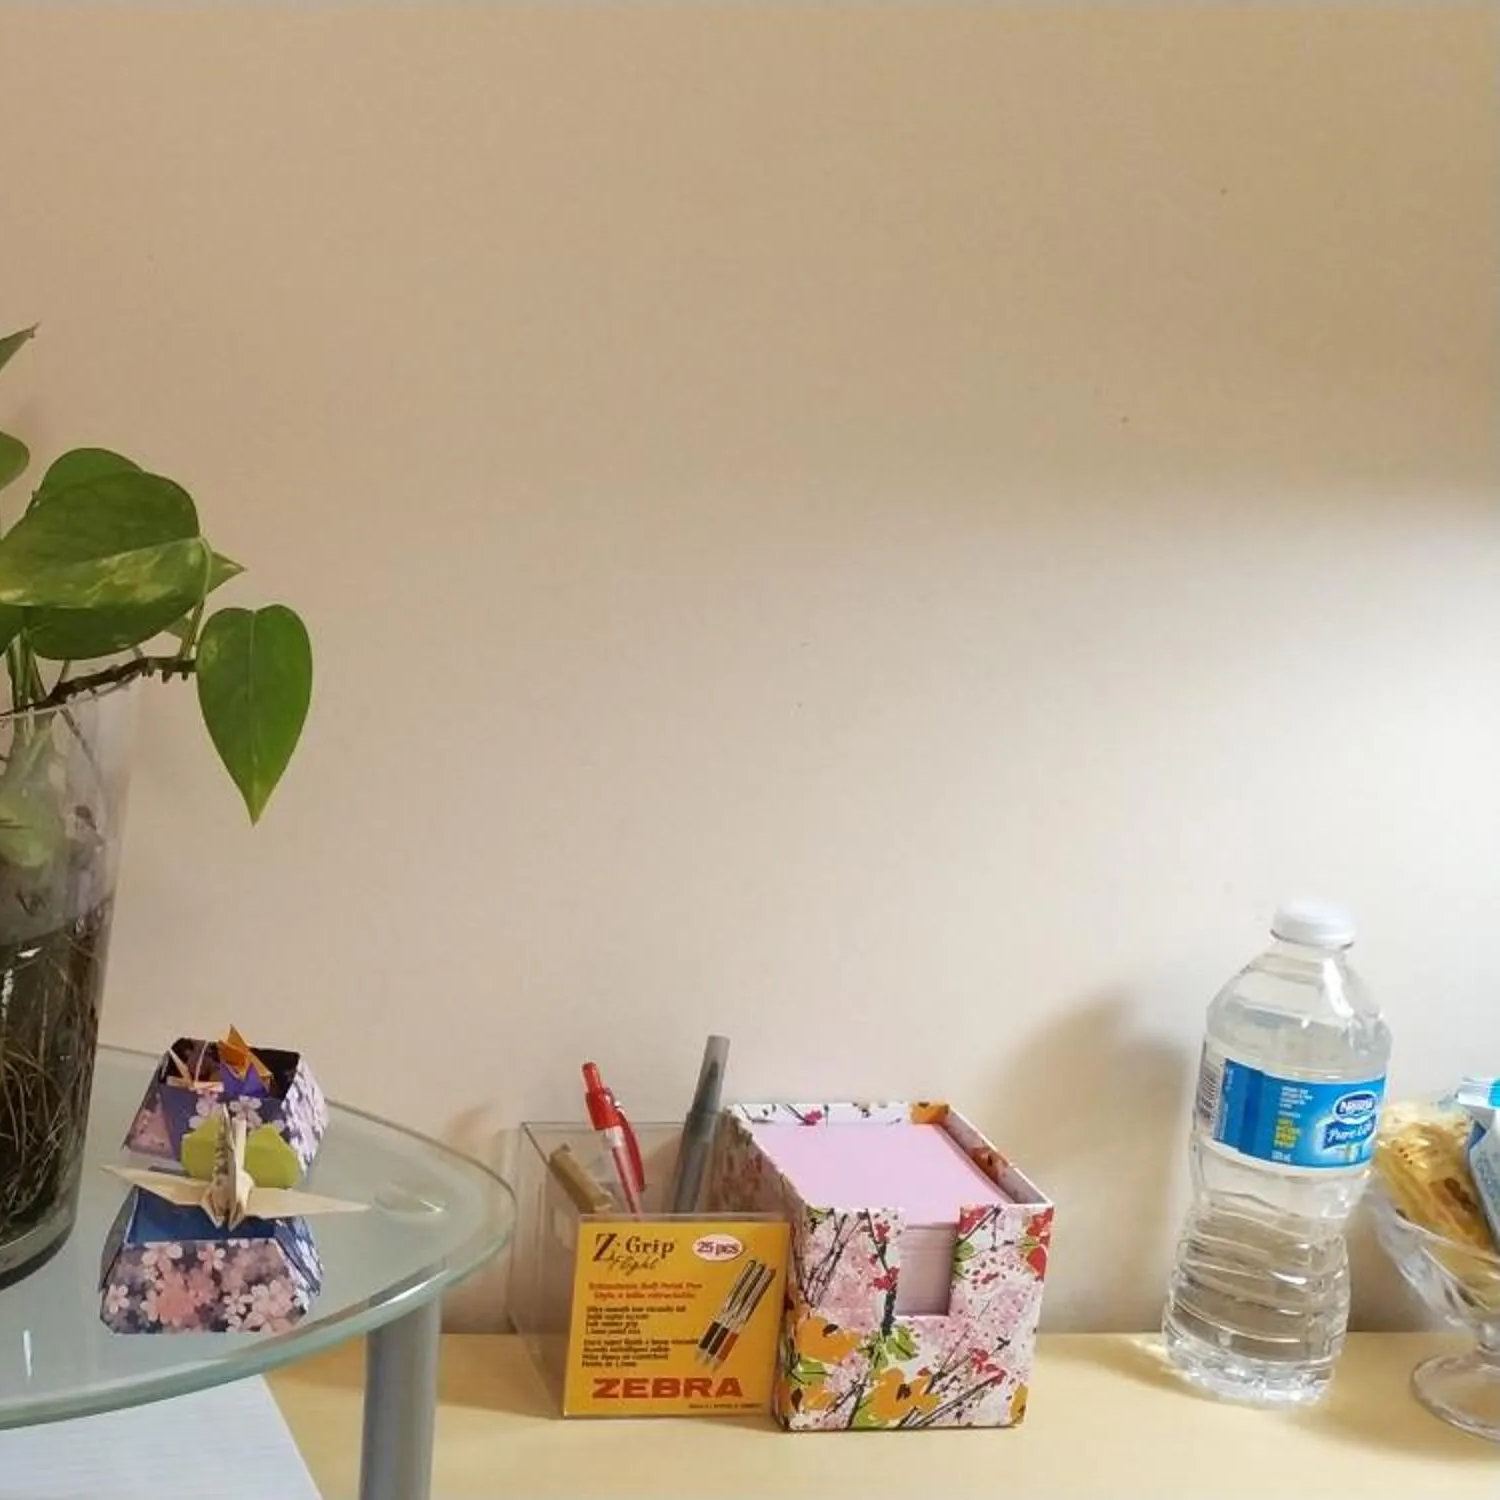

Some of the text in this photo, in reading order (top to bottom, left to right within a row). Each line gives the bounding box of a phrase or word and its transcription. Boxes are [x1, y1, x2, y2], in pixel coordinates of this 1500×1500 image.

[697, 1241, 740, 1255] 25 pcs
[592, 1377, 743, 1399] ZEBRA
